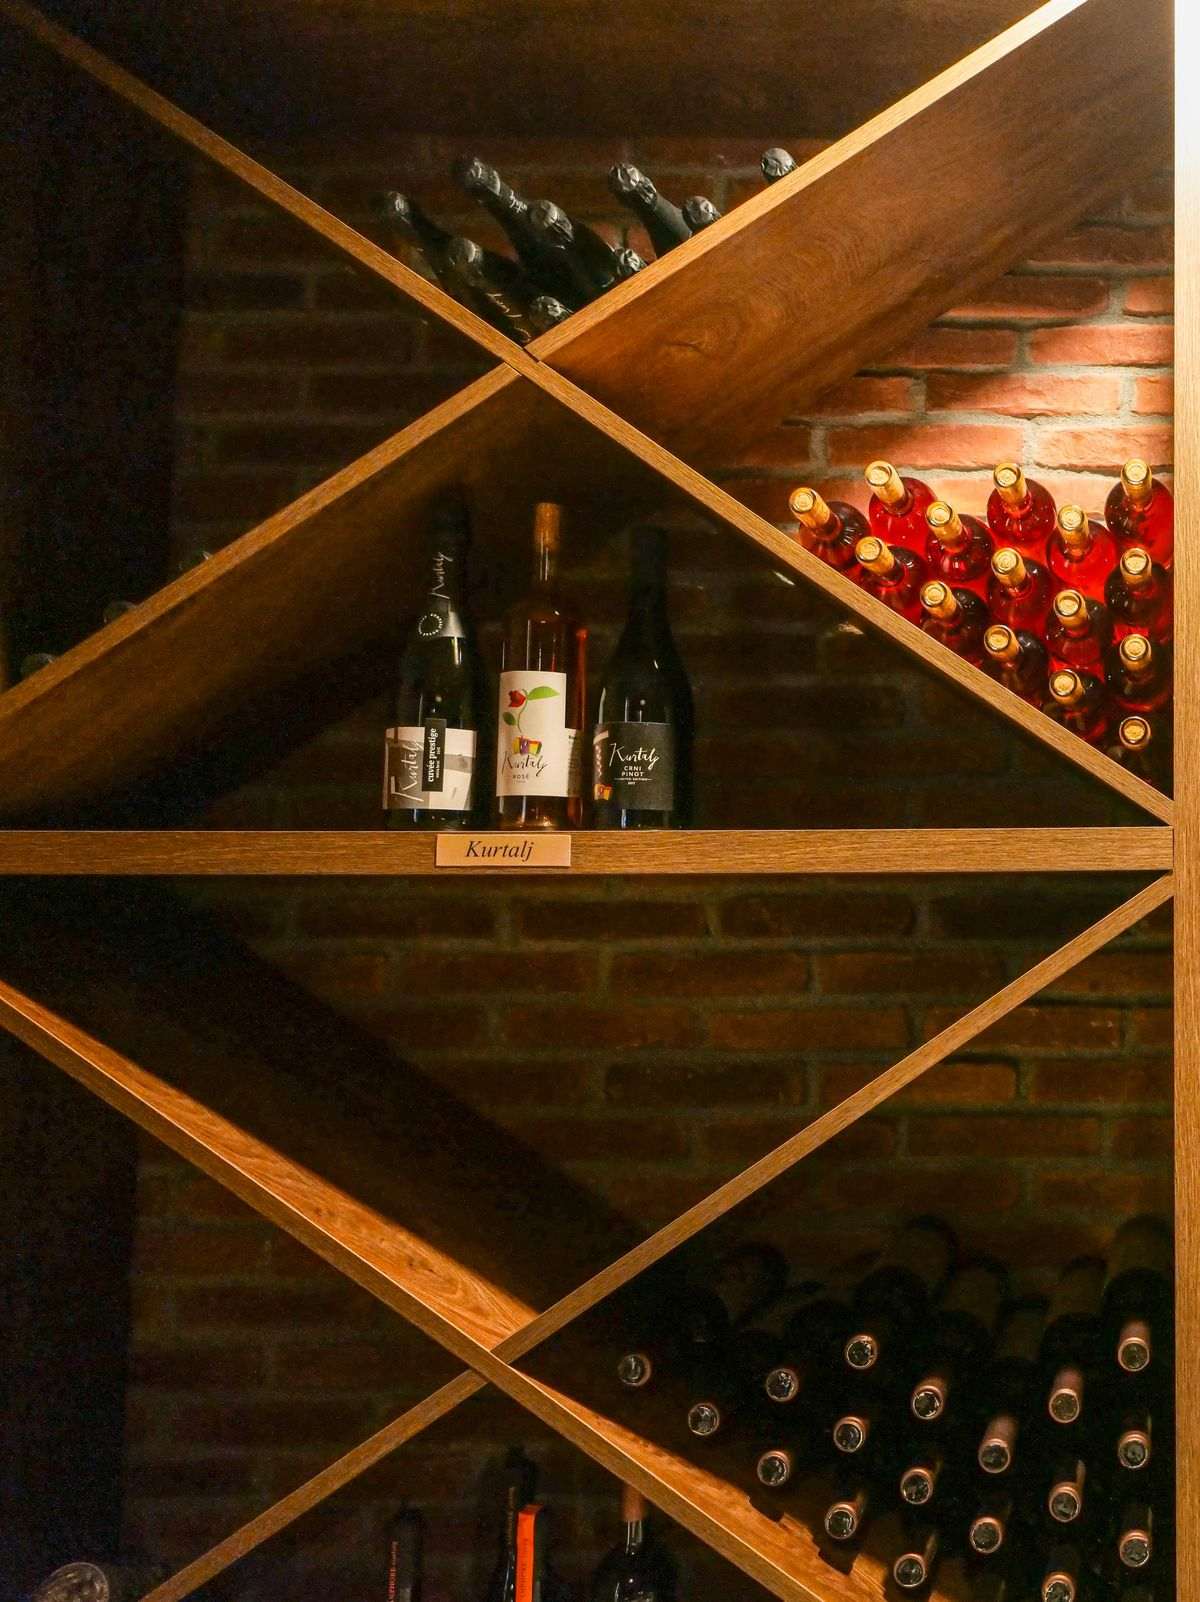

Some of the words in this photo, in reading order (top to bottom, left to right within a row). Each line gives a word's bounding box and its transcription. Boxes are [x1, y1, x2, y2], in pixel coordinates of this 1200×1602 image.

[427, 727, 439, 759] prestige
[426, 759, 436, 783] cuvée
[465, 840, 534, 861] Kurtalj
